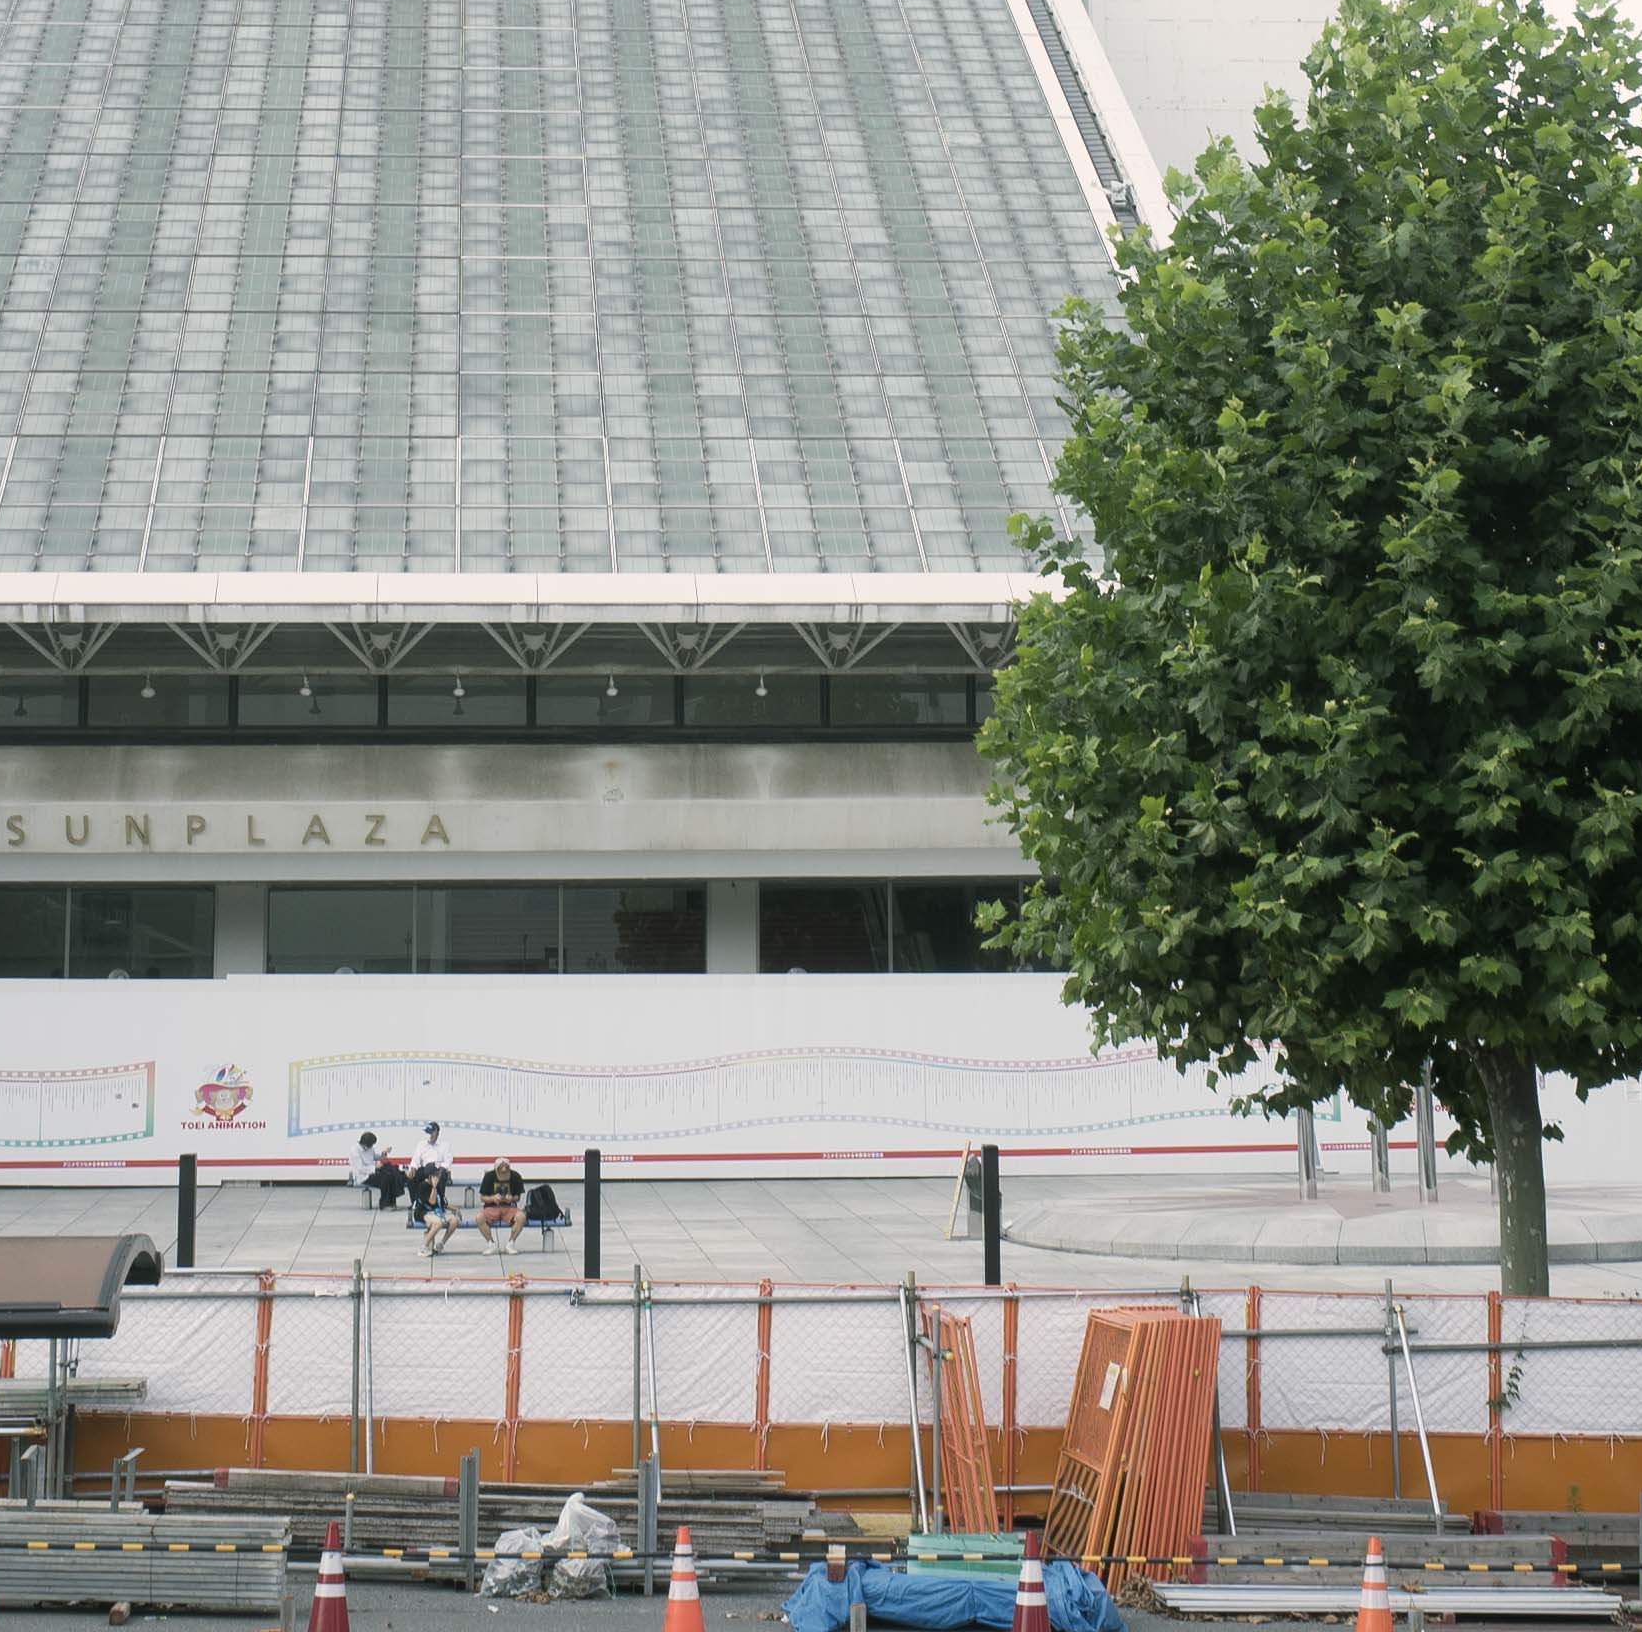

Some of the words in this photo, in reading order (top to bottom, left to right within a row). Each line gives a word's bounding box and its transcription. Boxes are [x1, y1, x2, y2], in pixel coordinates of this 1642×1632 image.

[5, 814, 451, 847] SUNPLAZA
[180, 1121, 205, 1130] TOEI
[207, 1121, 267, 1130] ANIMATION
